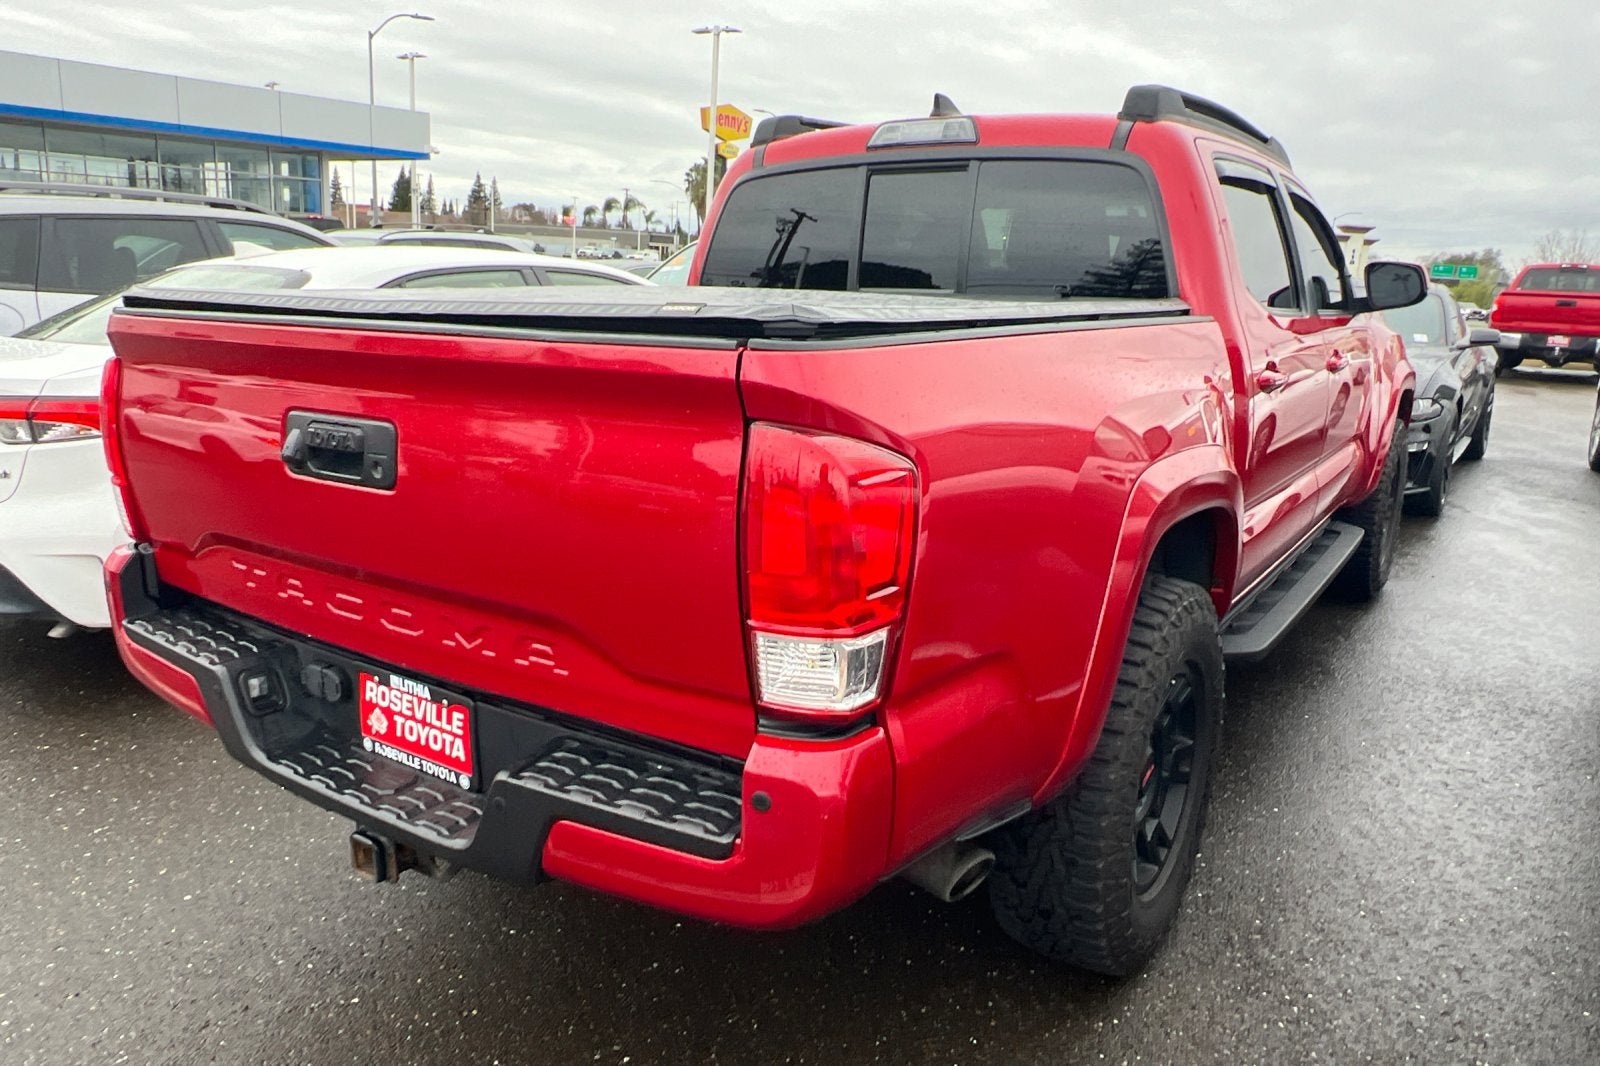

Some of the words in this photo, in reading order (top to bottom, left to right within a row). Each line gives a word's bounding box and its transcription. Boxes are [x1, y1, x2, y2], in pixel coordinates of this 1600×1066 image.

[717, 113, 749, 133] enny's
[231, 559, 570, 676] TACOMA
[365, 680, 464, 735] ROSEVILLE
[399, 677, 431, 700] LITHIA
[393, 715, 466, 762] TOYOTA
[374, 742, 421, 770] ROSEVILLE
[420, 761, 457, 784] TOYOTA
